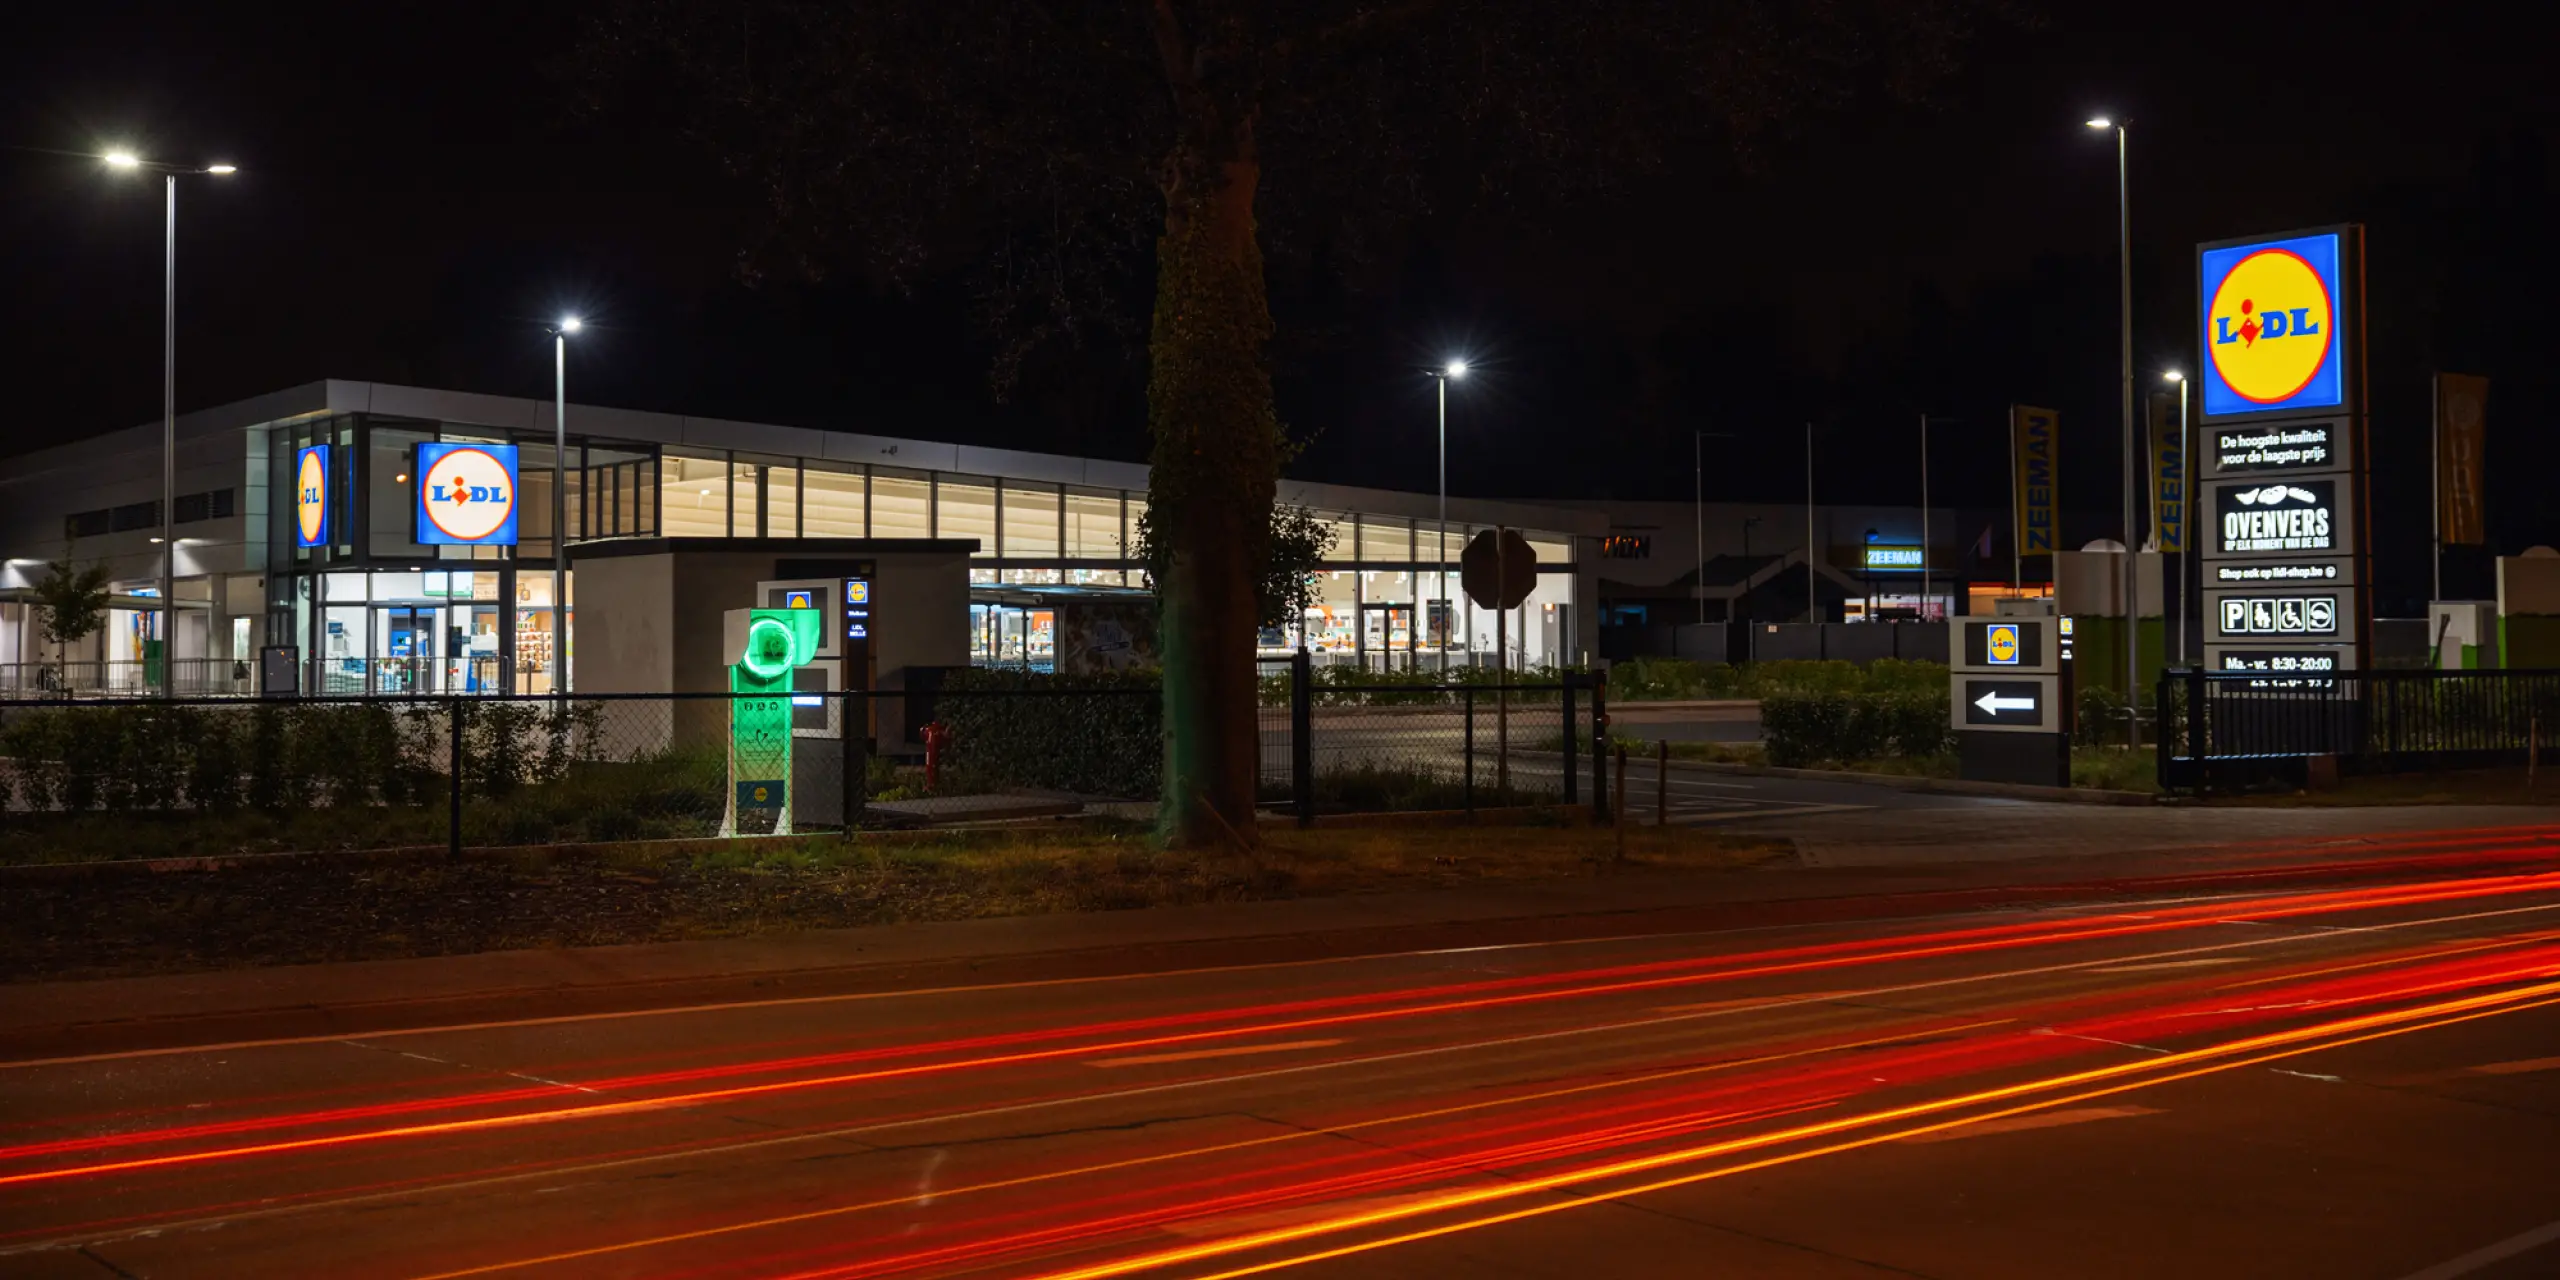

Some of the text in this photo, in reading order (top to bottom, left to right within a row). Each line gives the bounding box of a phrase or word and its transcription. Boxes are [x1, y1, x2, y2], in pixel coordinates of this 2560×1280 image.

[2216, 298, 2319, 349] LIDL
[2221, 429, 2326, 449] De hoogste kwaliteit
[2222, 446, 2326, 464] voor de laagste prijs
[432, 476, 507, 506] LIDL
[2028, 415, 2052, 550] ZEEMAN
[2225, 508, 2329, 539] OVENVERS
[1867, 550, 1923, 564] ZEEMAN
[2219, 567, 2242, 580] Shop
[2271, 657, 2332, 670] 8:30-20:00
